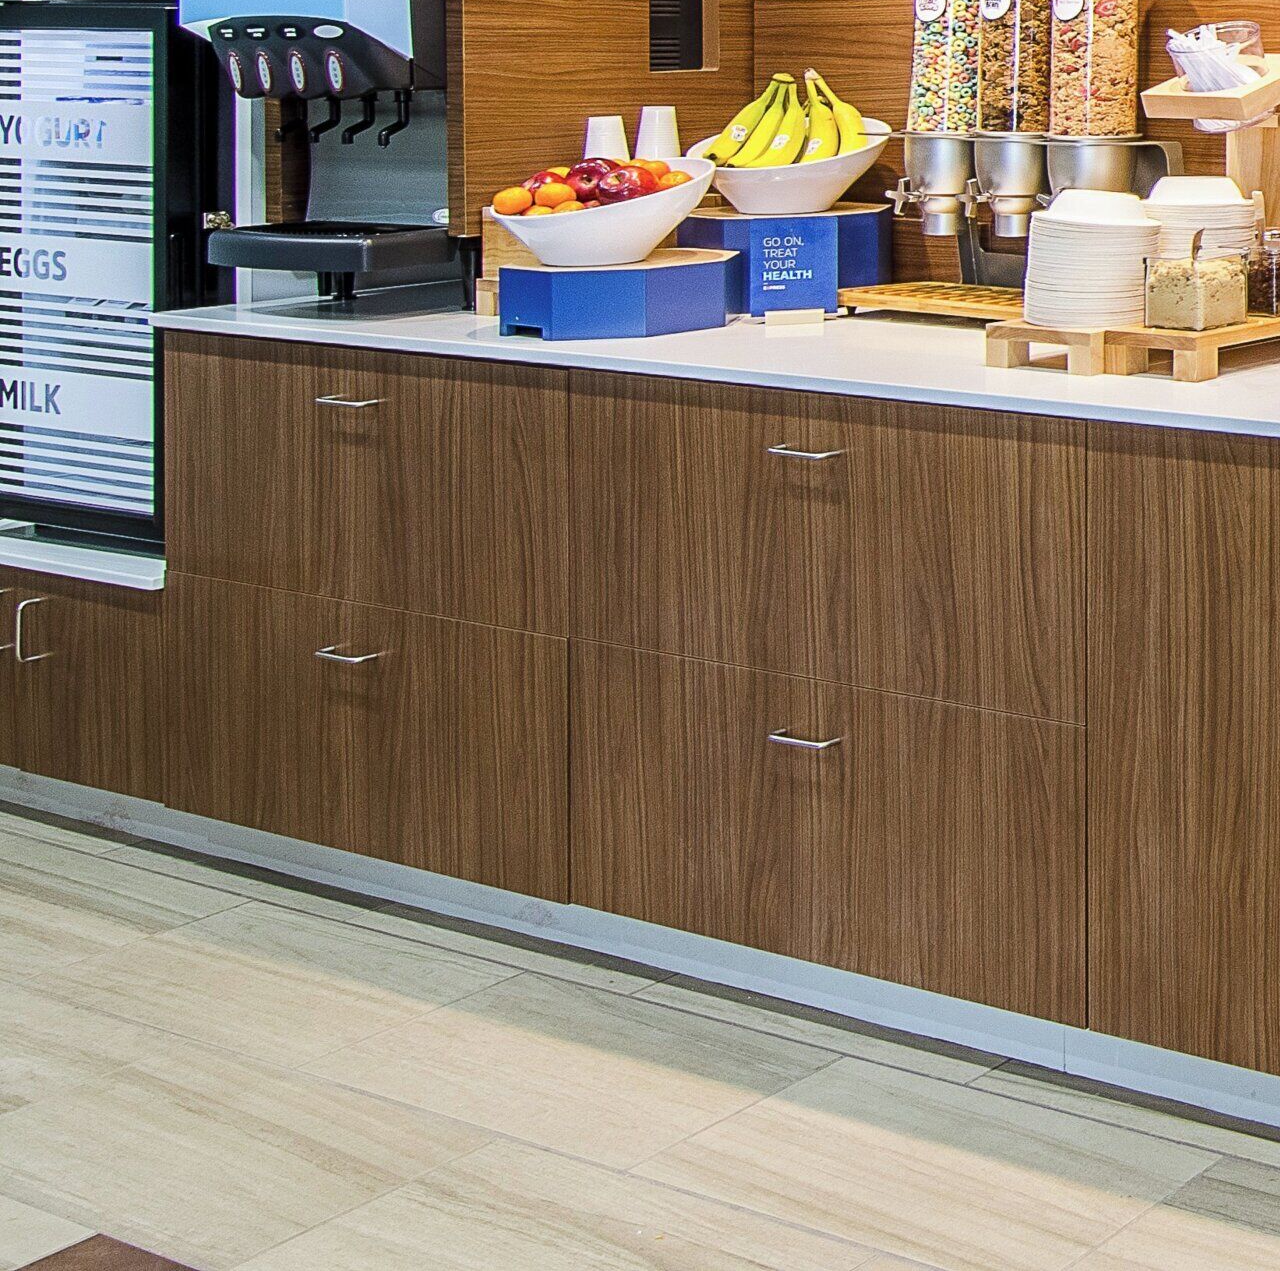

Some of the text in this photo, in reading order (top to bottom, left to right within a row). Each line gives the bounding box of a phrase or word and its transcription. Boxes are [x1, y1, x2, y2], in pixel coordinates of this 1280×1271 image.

[763, 237, 781, 247] GO
[763, 247, 798, 258] TREAT
[0, 246, 67, 282] EGGS
[763, 259, 796, 270] YOUR
[763, 269, 813, 281] HEALTH
[0, 380, 61, 415] MILK
